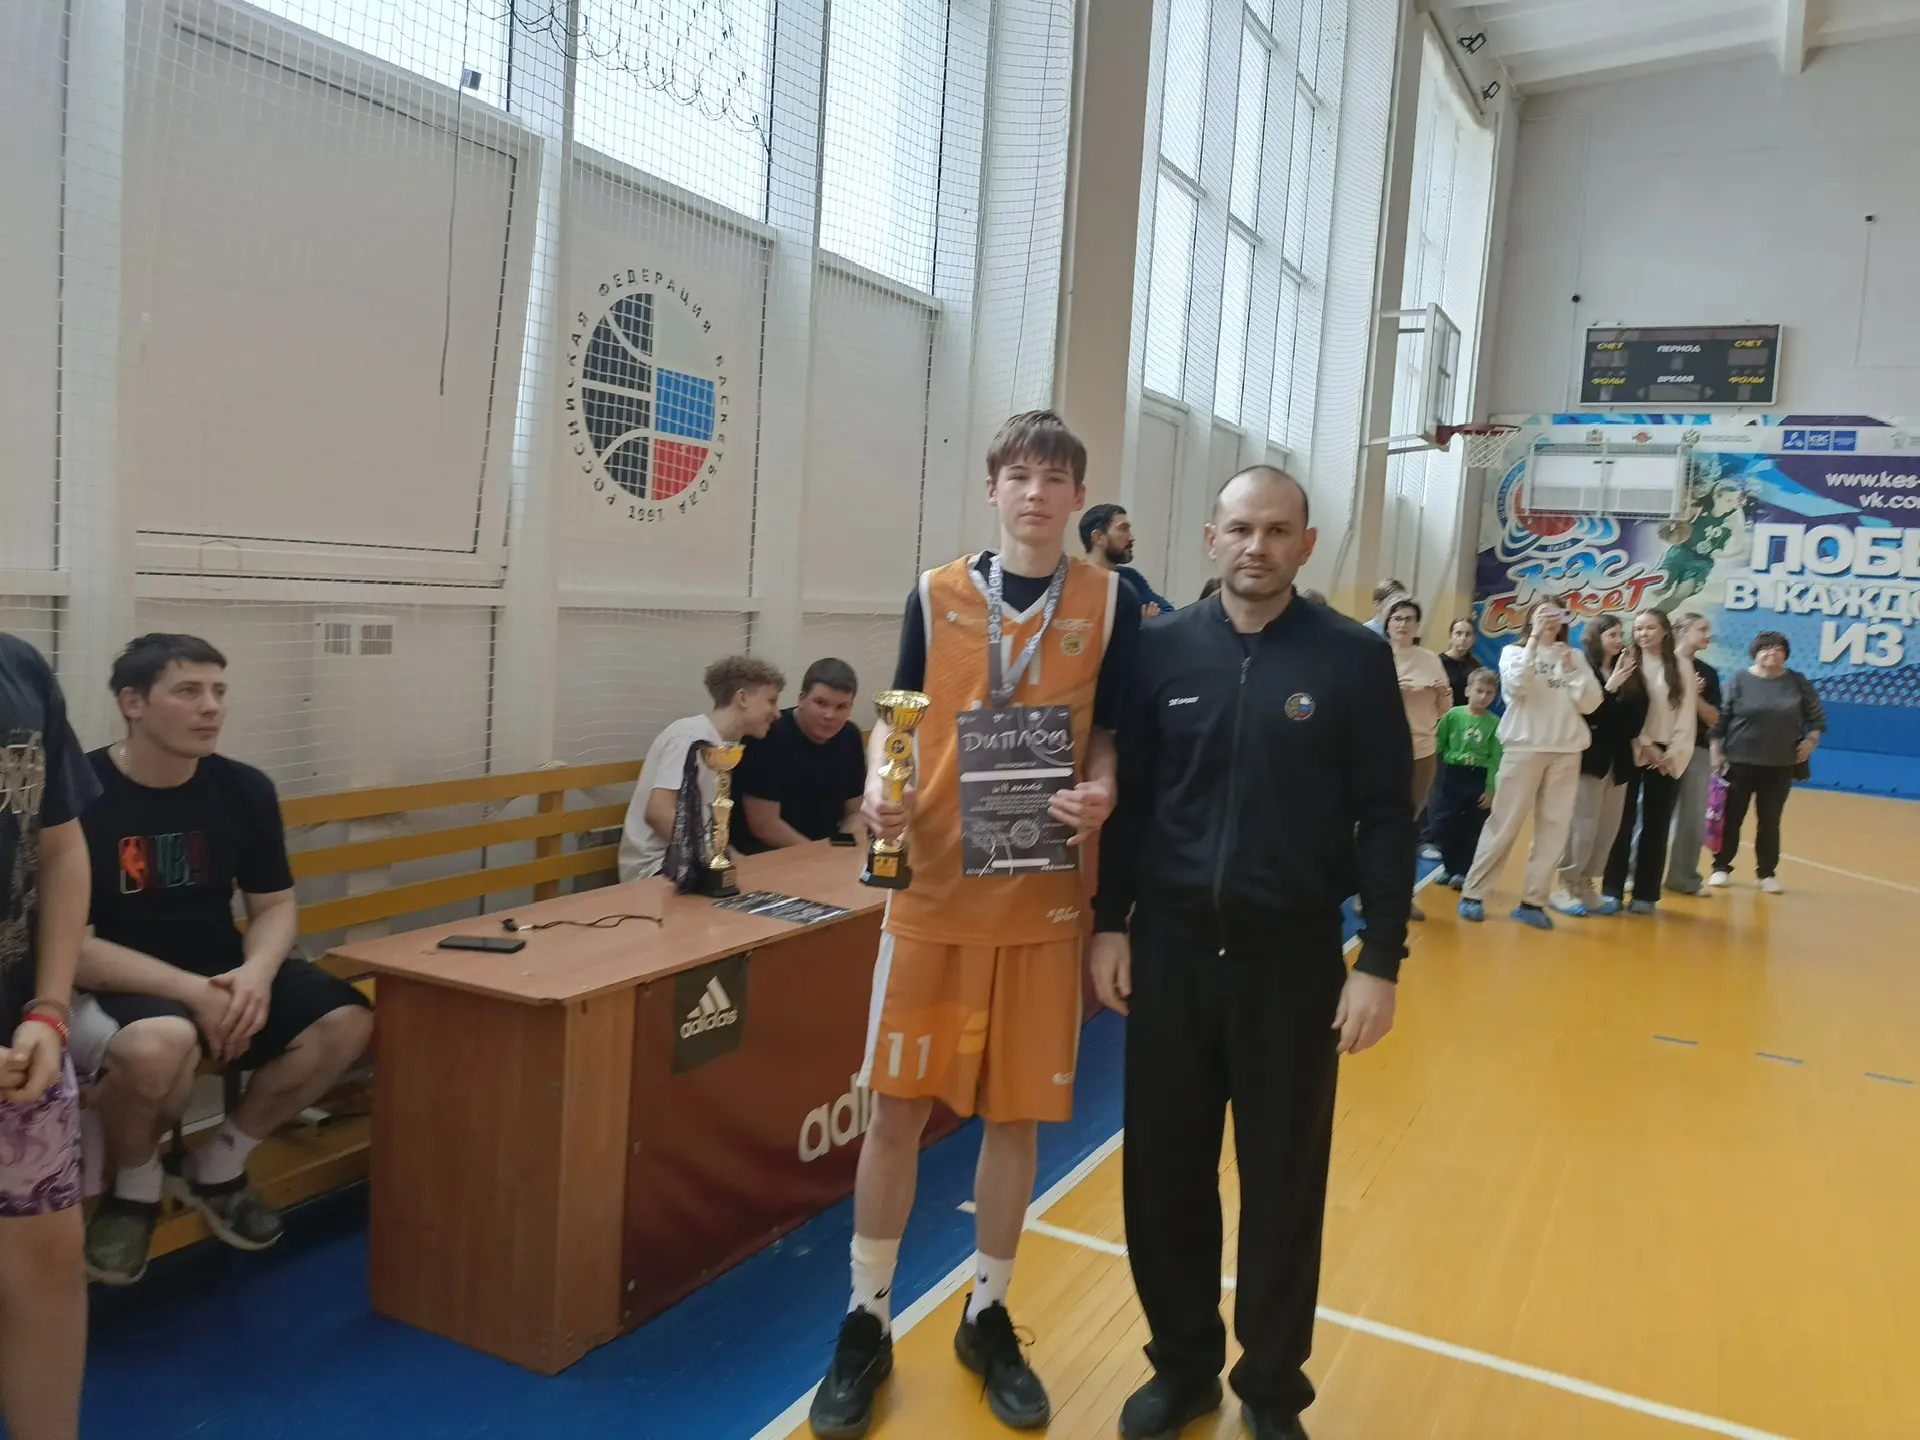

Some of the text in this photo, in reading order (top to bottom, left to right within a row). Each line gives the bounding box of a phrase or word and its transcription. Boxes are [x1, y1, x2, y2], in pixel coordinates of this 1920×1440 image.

[1656, 344, 1701, 353] ПЕРИОД
[1859, 491, 1920, 508] vk.co
[1726, 578, 1757, 610] В
[1818, 621, 1903, 667] ИЗ
[680, 1007, 738, 1039] adidas
[888, 1032, 932, 1080] 11
